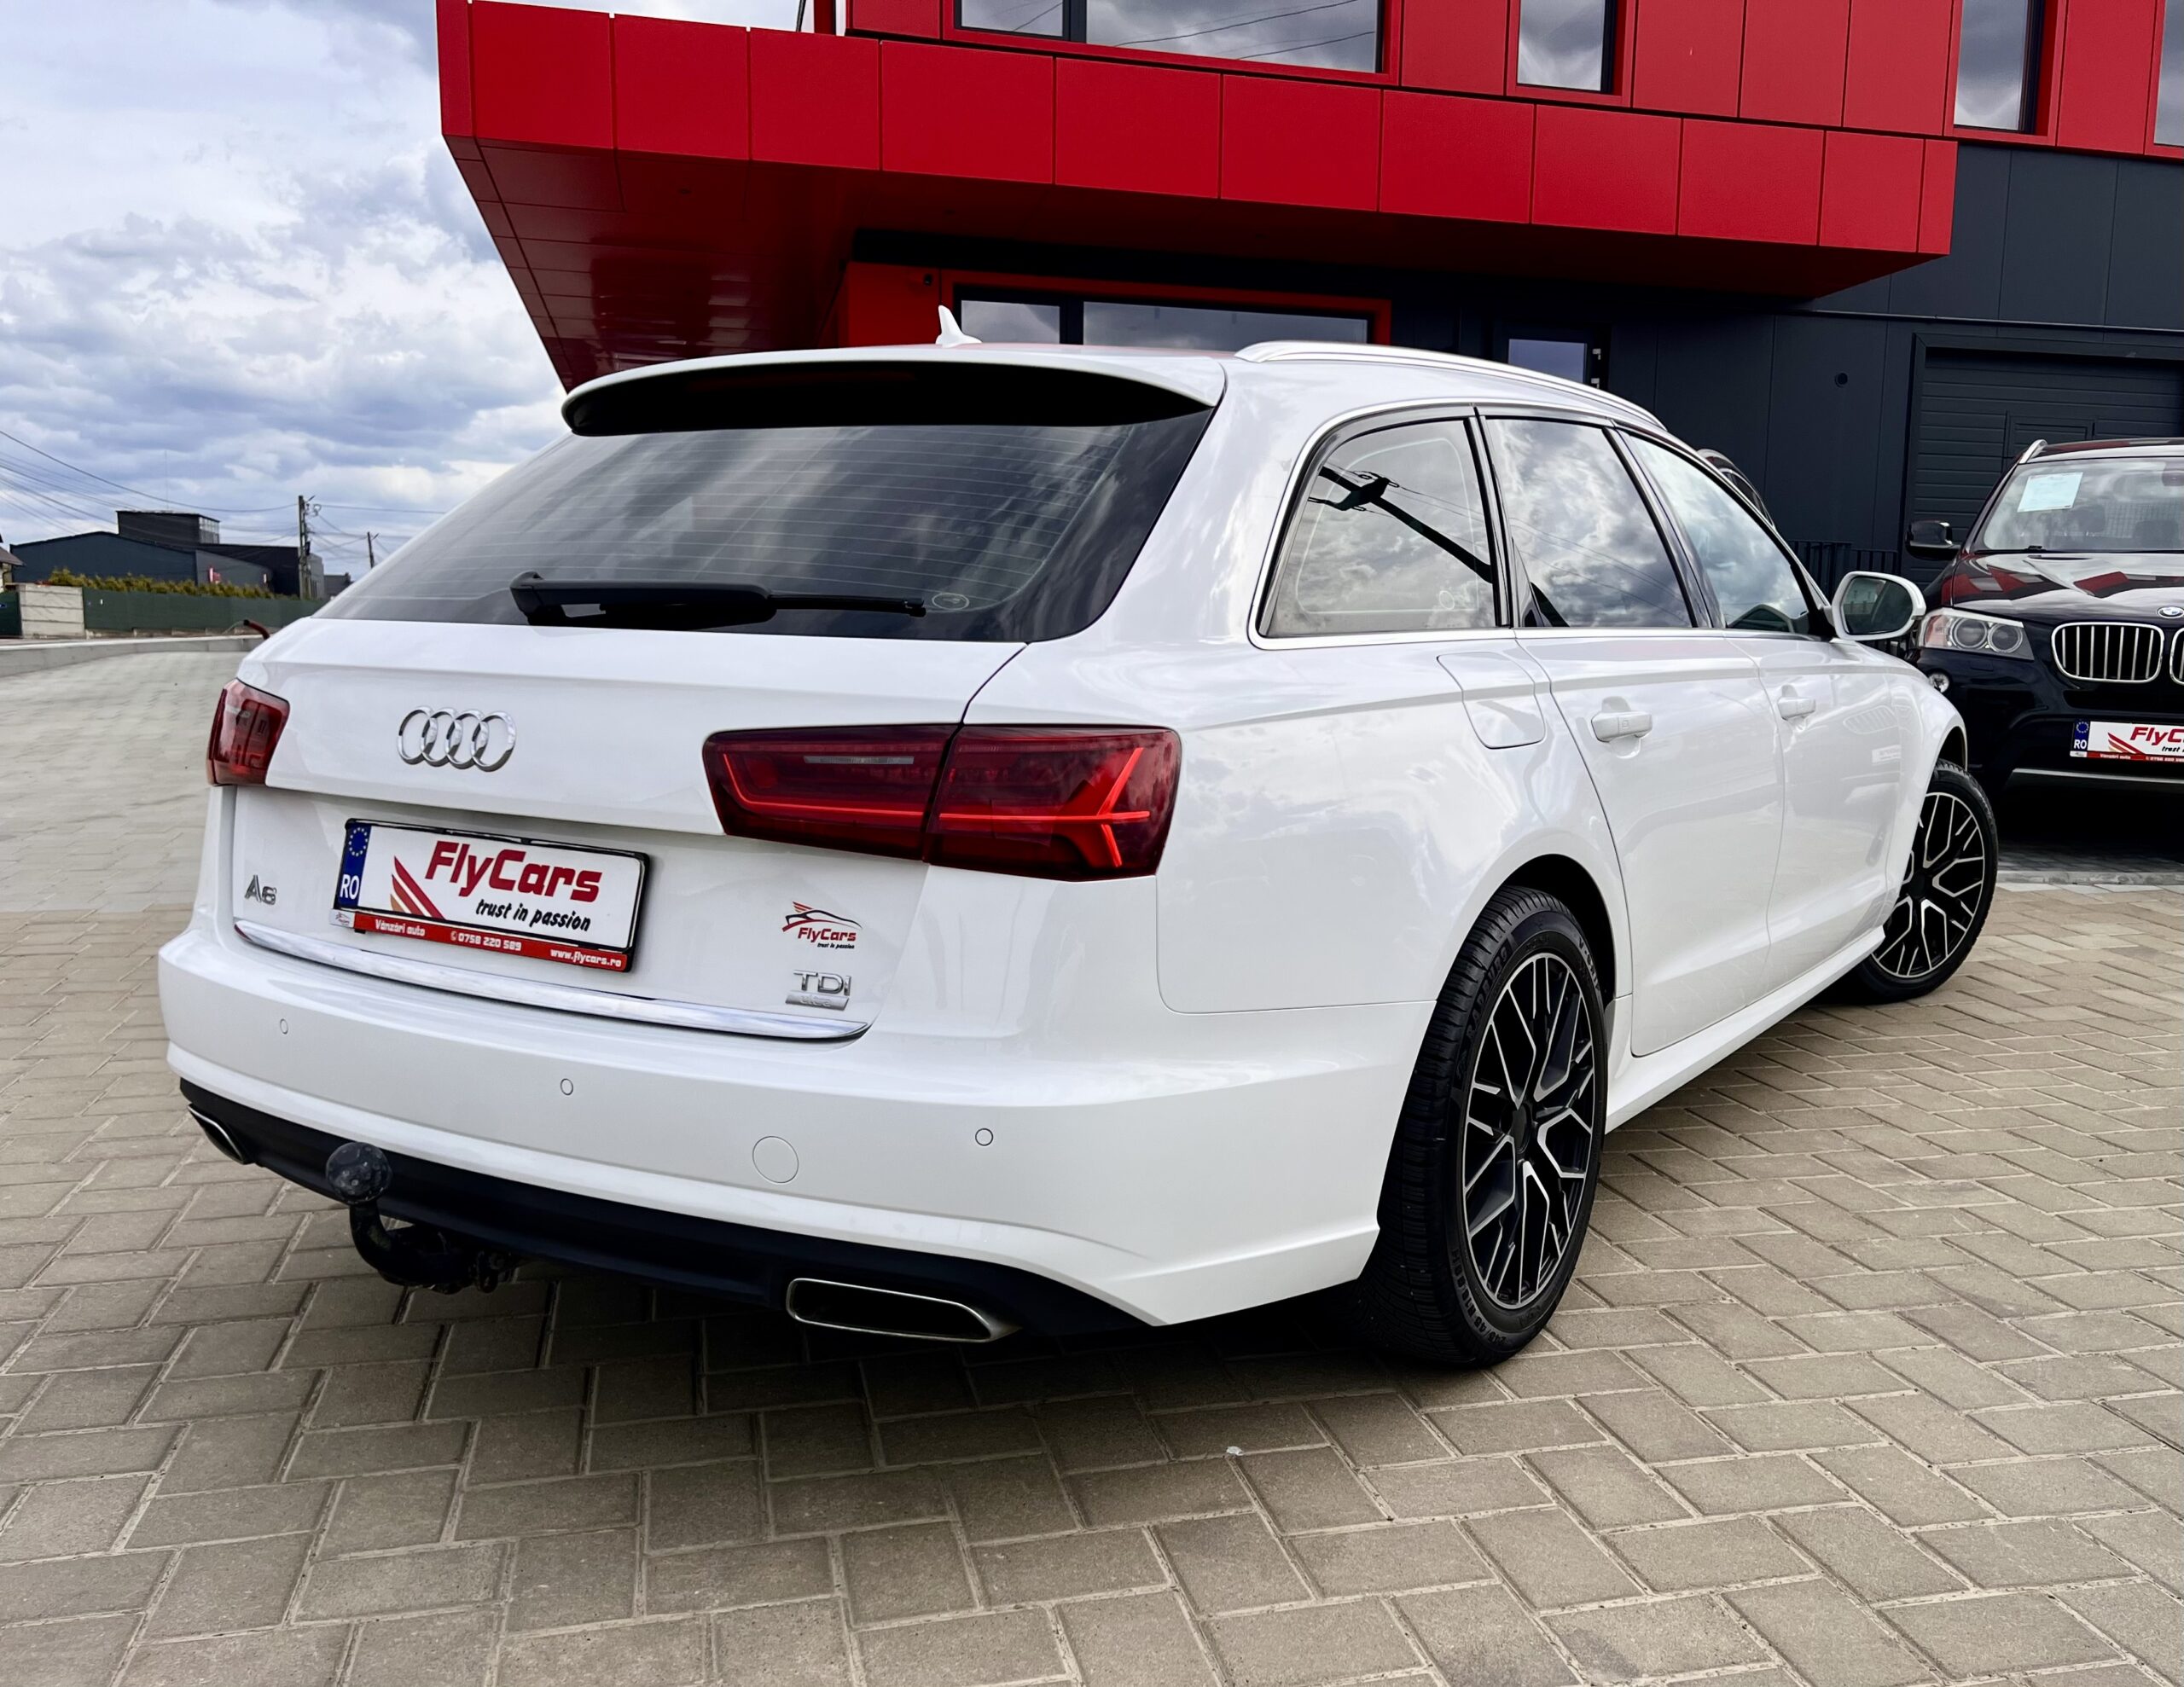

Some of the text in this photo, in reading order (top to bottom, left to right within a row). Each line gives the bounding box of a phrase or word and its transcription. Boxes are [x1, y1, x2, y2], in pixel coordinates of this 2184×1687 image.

[2073, 739, 2088, 750] RO
[2129, 727, 2184, 746] FlyC
[425, 840, 602, 902] FlyCars
[244, 874, 277, 906] A6
[340, 873, 359, 900] RO
[476, 899, 591, 931] trust in passion
[407, 925, 426, 937] auto
[483, 936, 502, 948] 220
[550, 949, 622, 967] www.flycars.ro
[798, 927, 857, 942] FlyCars
[793, 970, 851, 996] TDI
